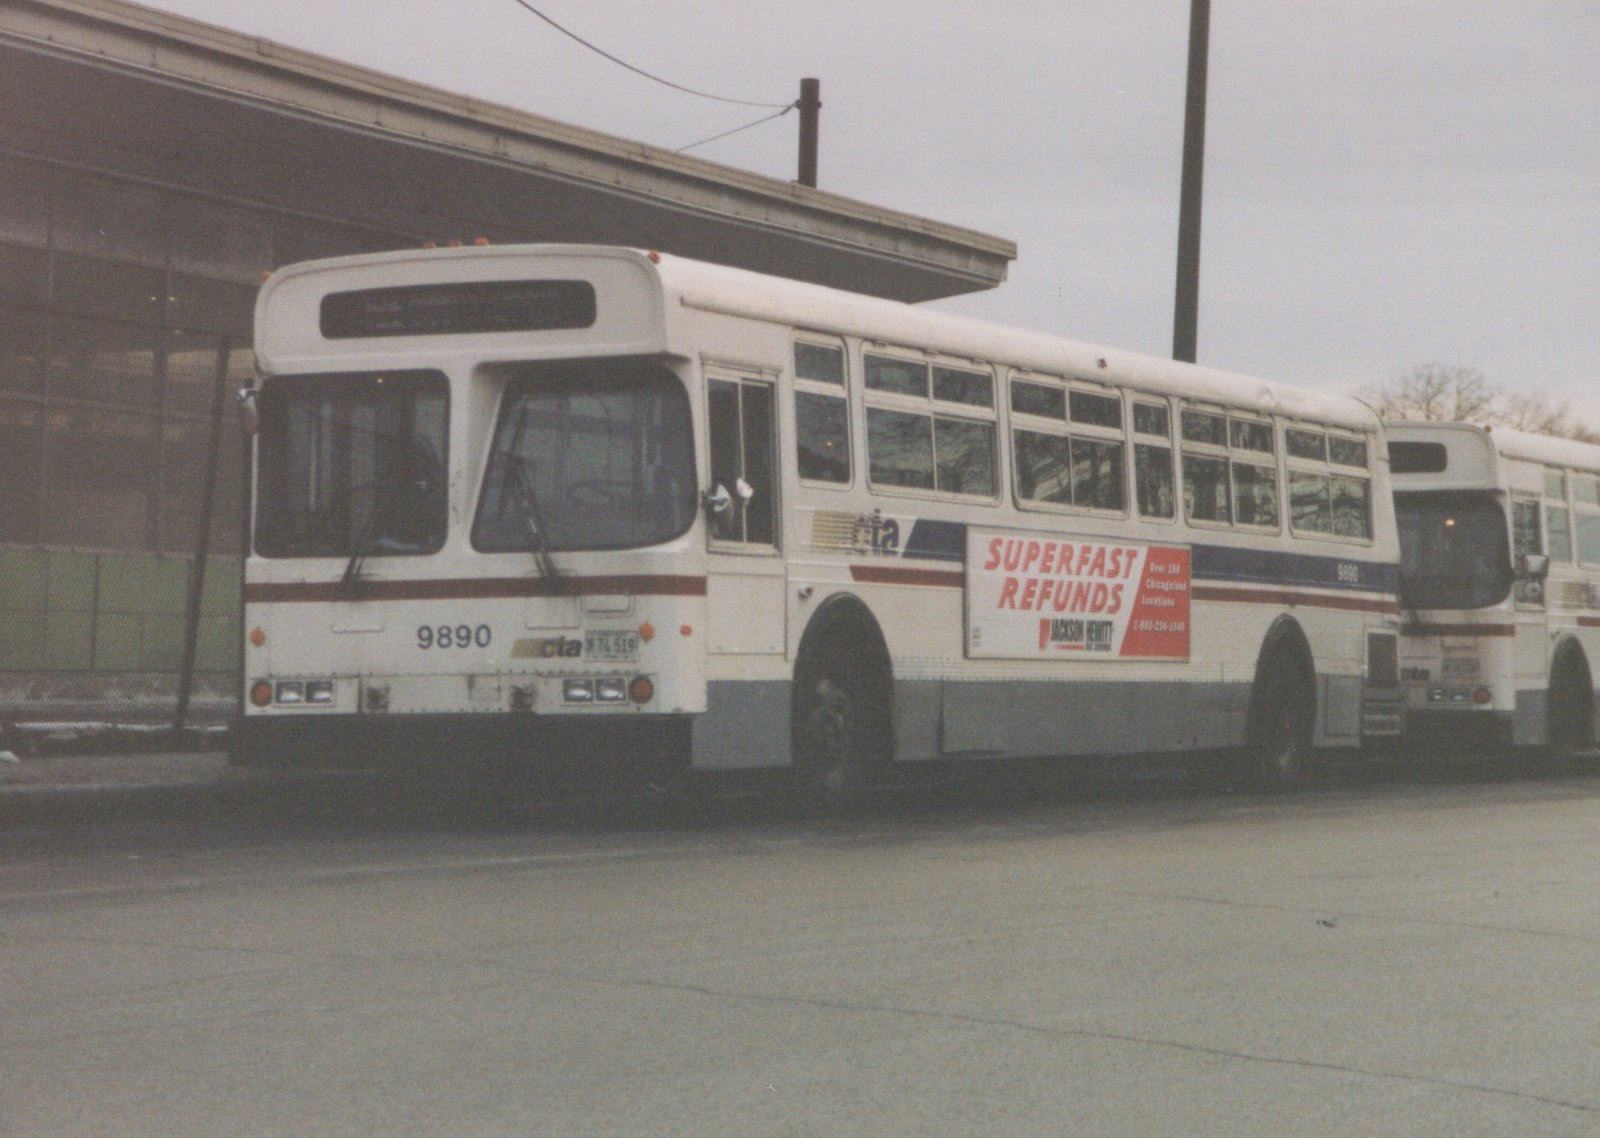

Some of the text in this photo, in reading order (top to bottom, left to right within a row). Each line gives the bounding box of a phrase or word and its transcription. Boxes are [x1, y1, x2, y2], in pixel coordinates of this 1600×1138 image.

[984, 538, 1138, 579] SUPERFAST
[1149, 562, 1166, 573] Over
[997, 577, 1124, 614] REFUNDS
[1146, 578, 1187, 591] Chicagoland
[1142, 594, 1175, 607] Locations
[417, 624, 492, 649] 9890
[1051, 618, 1113, 643] JACKSON HEWITT
[540, 636, 583, 658] cta
